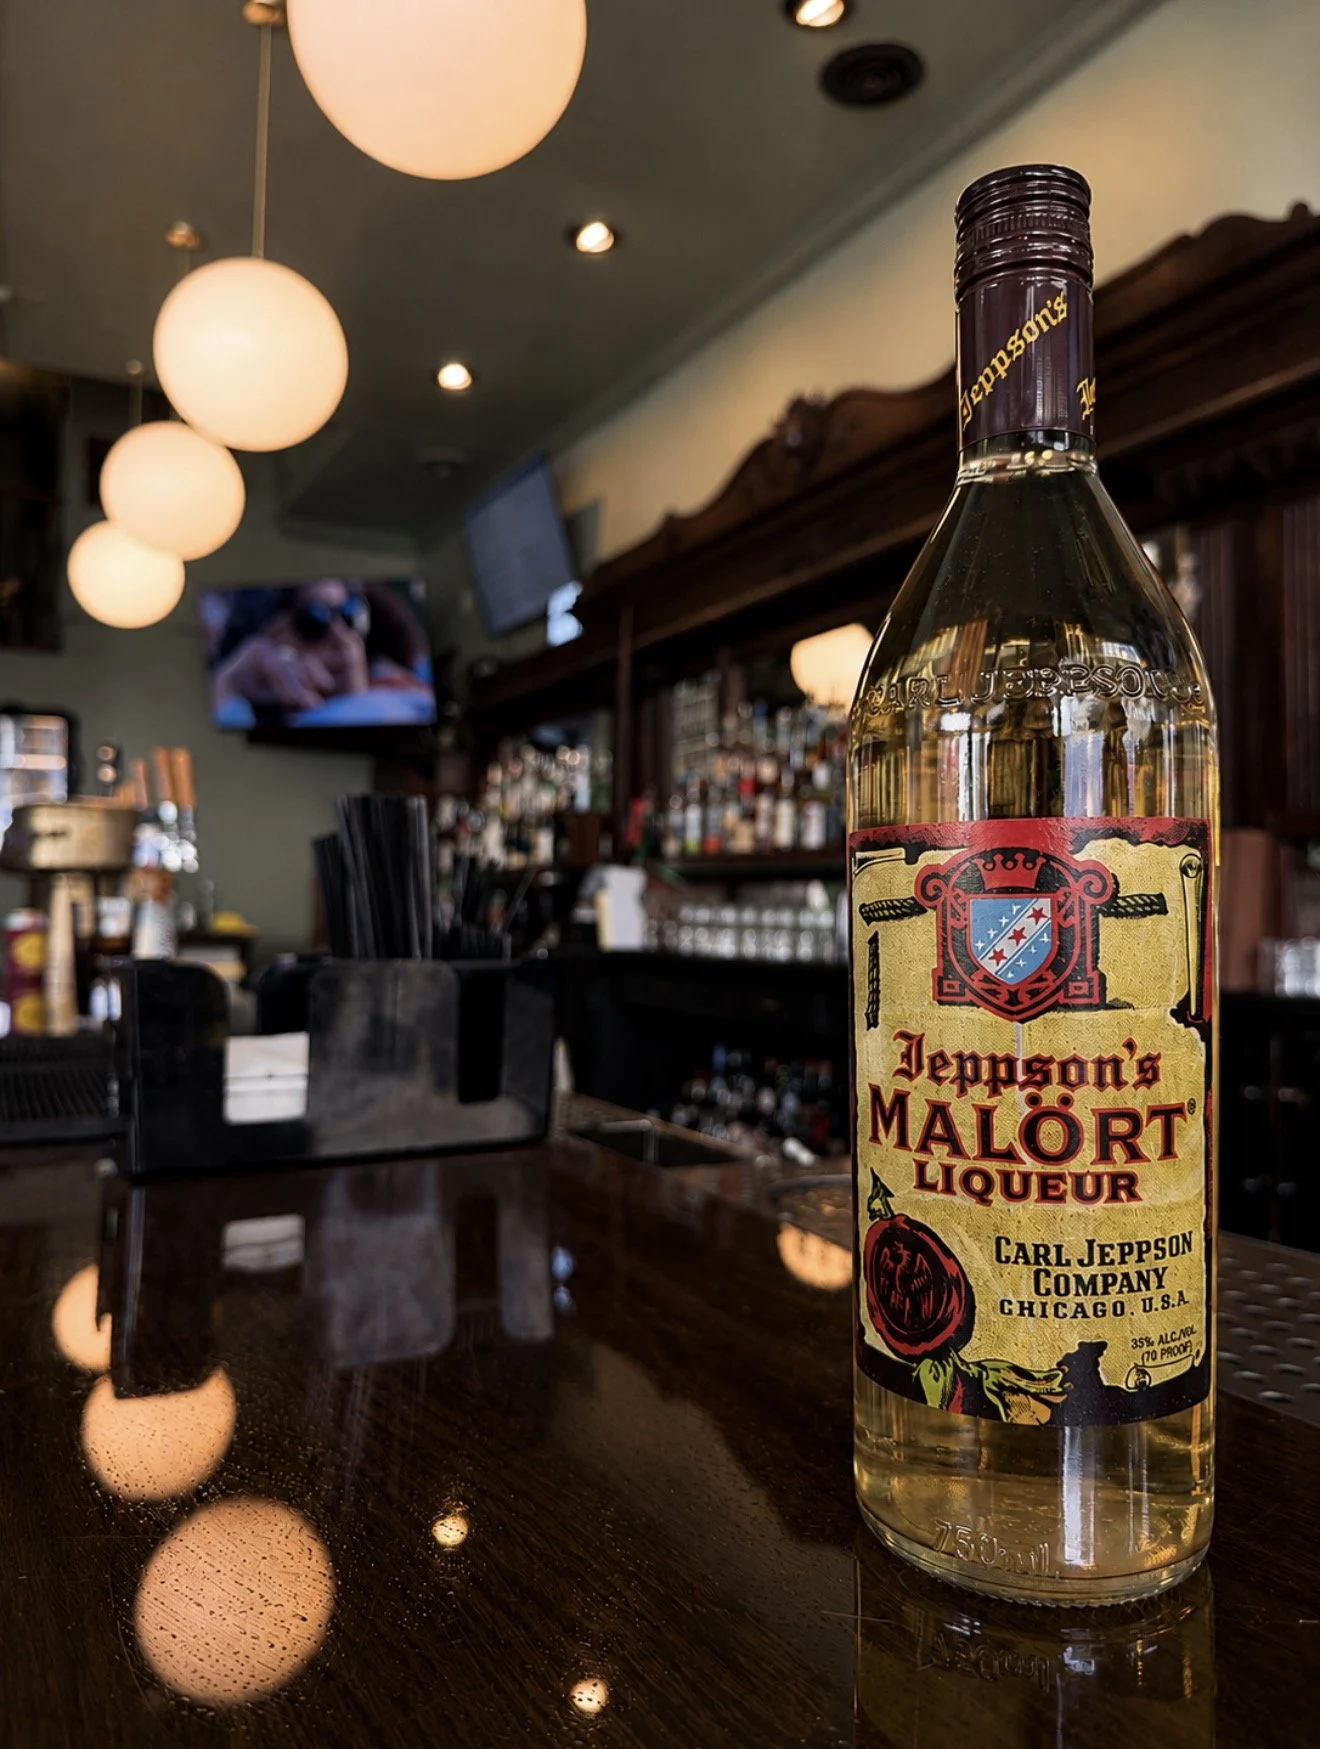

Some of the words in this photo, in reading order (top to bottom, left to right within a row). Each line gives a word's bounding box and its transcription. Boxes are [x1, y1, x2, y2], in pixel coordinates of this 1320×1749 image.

[959, 291, 1068, 431] Jeppson's
[892, 1029, 1162, 1099] Jeppson's
[913, 1158, 1143, 1207] LIQUEUR
[994, 1235, 1071, 1267] CARL
[1077, 1231, 1193, 1267] JEPPSON
[1033, 1267, 1168, 1297] COMPANY
[1131, 1336, 1155, 1350] 35%
